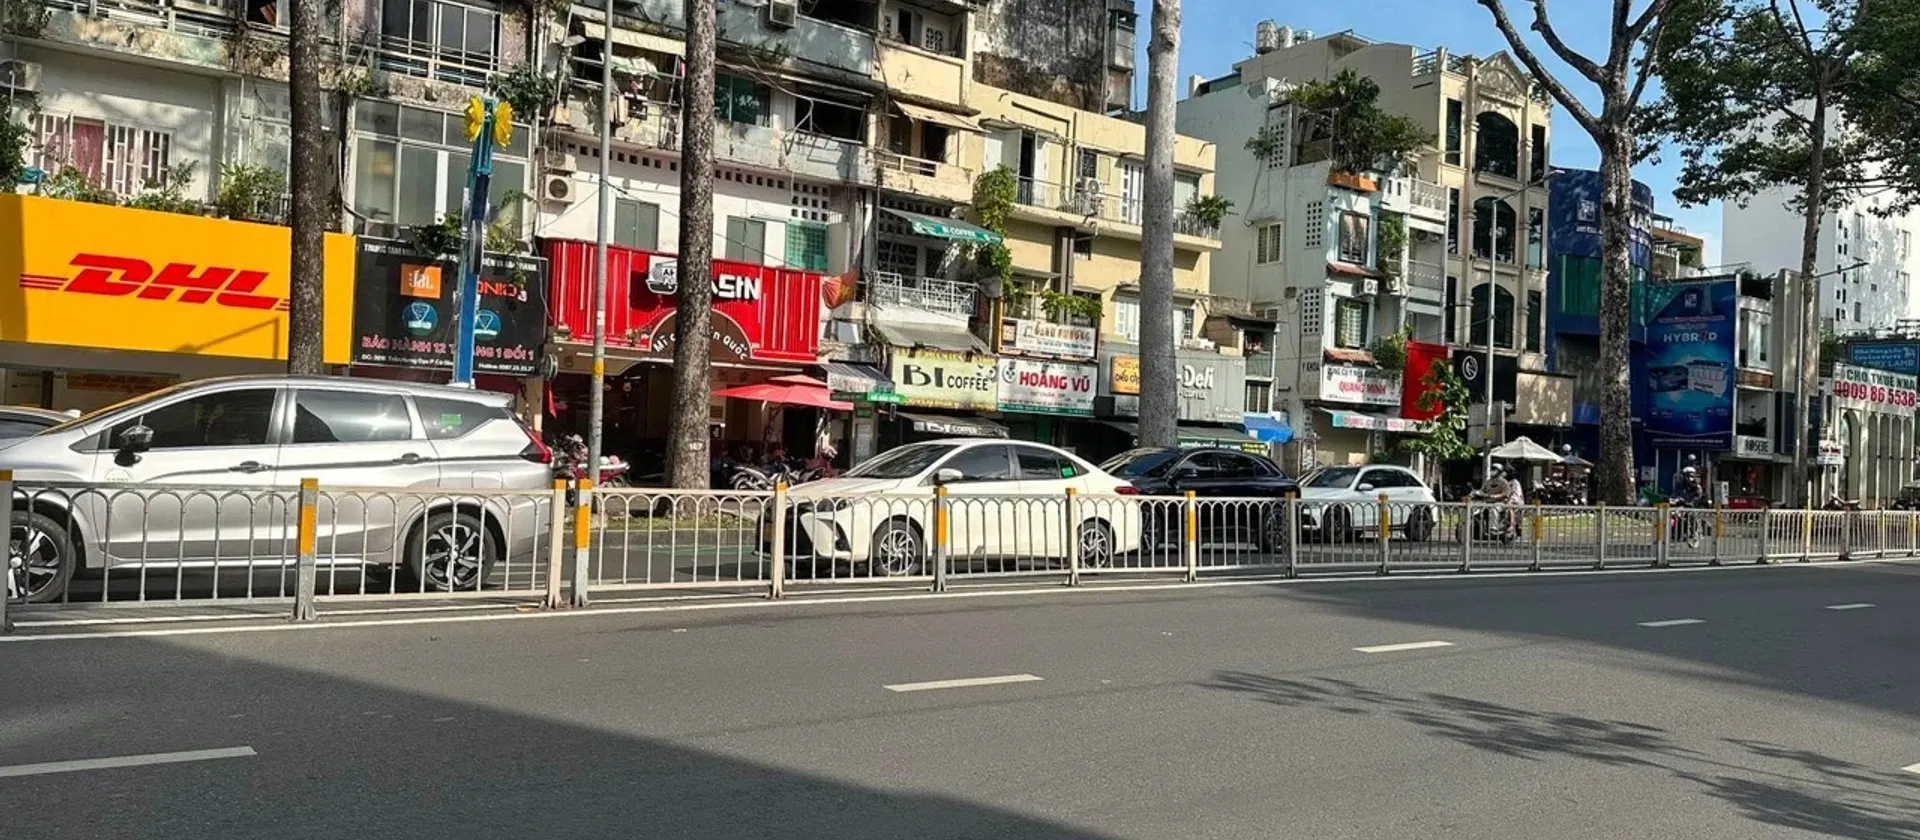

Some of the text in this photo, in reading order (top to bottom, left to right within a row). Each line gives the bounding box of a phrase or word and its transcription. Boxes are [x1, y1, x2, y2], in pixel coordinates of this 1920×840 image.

[64, 253, 279, 310] DHL
[903, 364, 943, 388] BI
[946, 375, 988, 392] COFFEE
[1071, 375, 1091, 393] VŨ
[1846, 369, 1868, 383] CHO
[1834, 380, 1915, 408] 0909 86 5538
